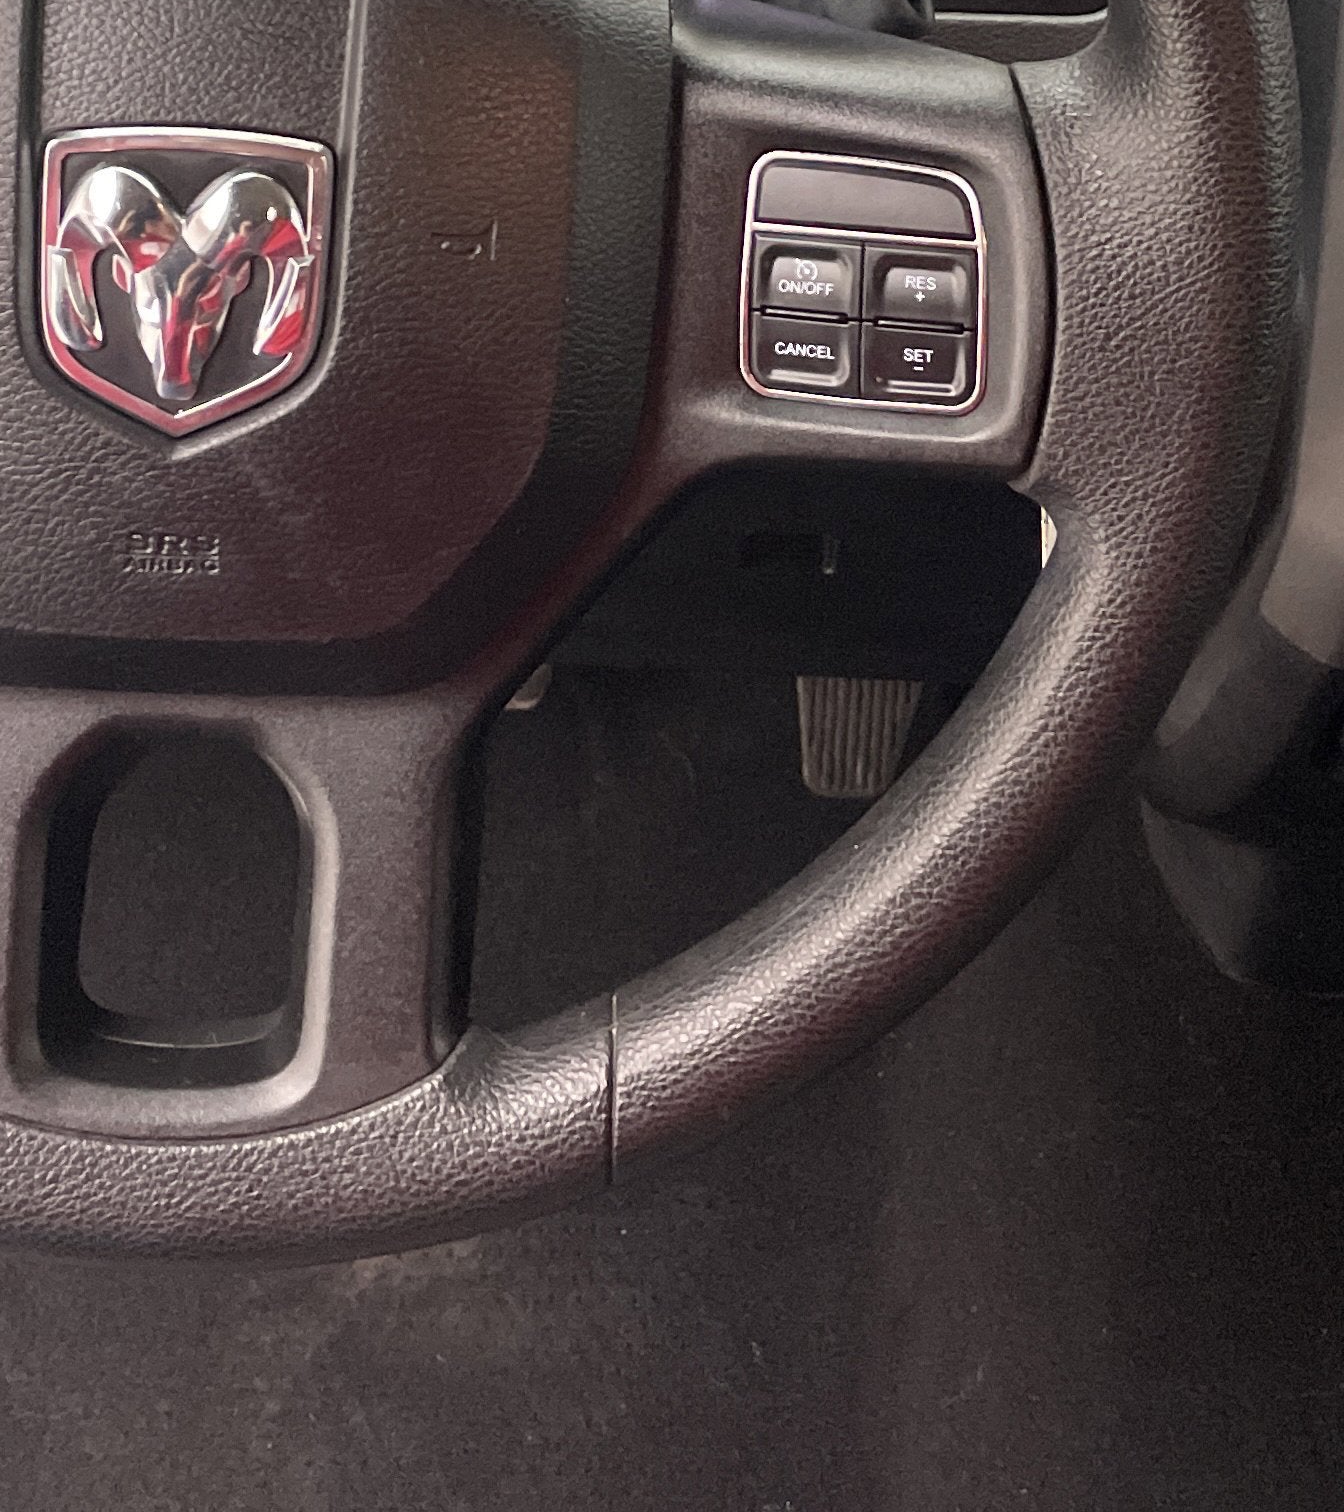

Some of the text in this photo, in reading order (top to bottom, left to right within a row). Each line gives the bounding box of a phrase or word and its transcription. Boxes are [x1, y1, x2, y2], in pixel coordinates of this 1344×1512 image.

[778, 279, 834, 296] ON/OFF
[904, 274, 937, 290] RES
[774, 341, 835, 360] CANCEL
[903, 347, 934, 363] SET
